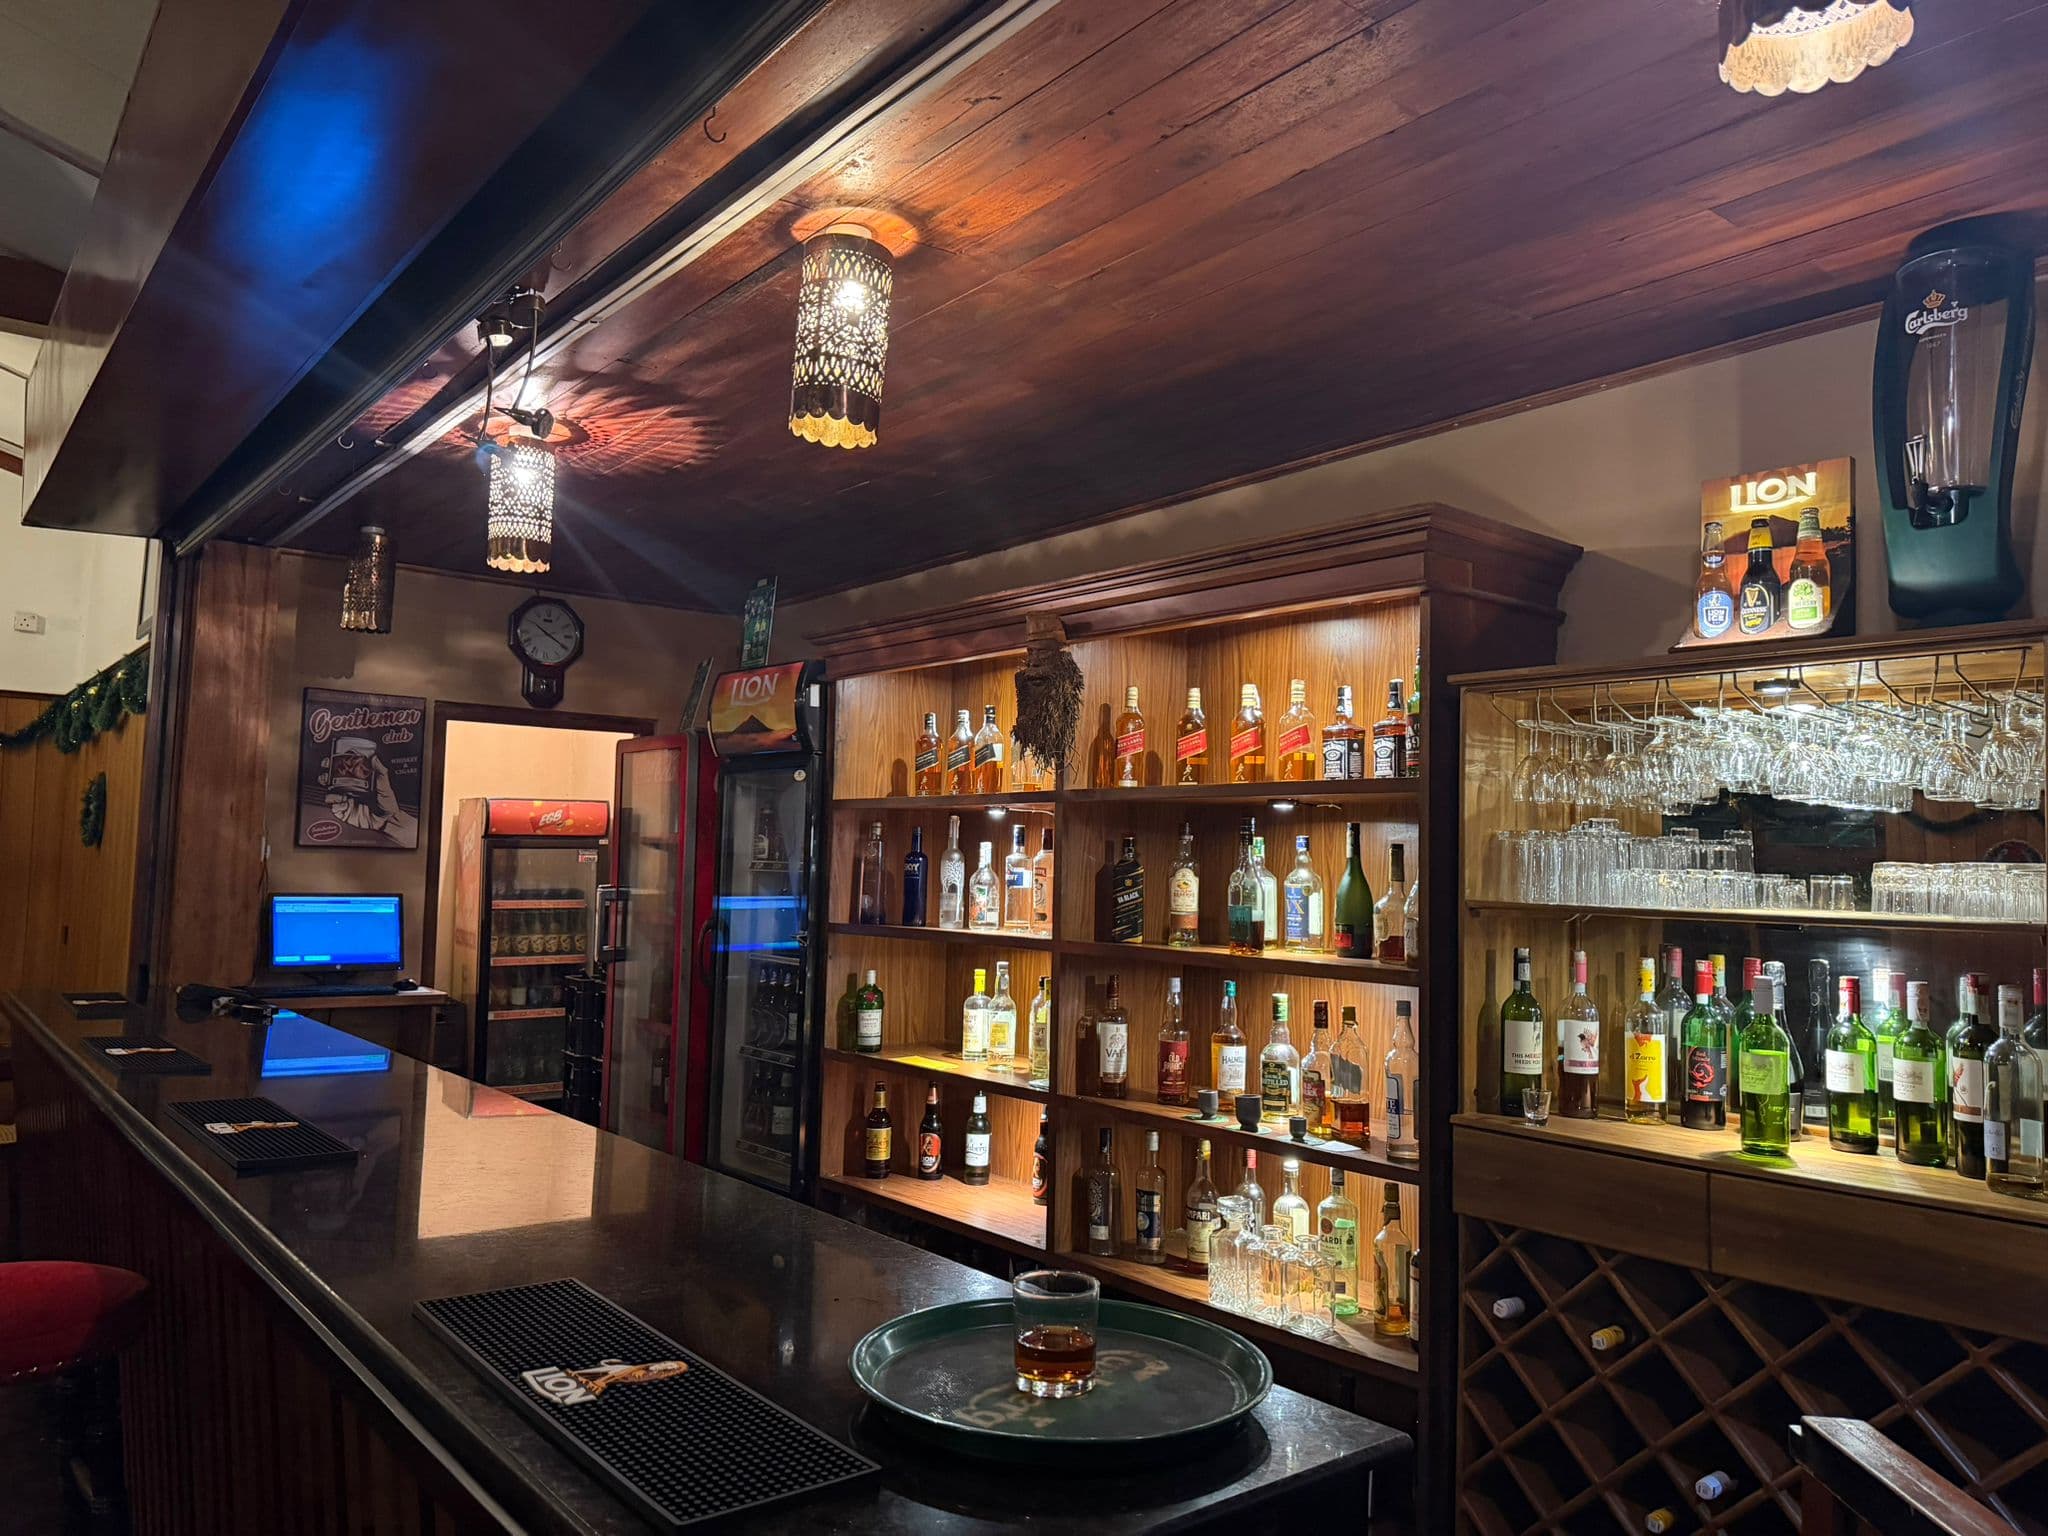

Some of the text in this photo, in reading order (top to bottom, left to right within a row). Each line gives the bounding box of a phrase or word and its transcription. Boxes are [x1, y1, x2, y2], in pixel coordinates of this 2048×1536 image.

[1905, 302, 1969, 334] Carlsberg
[1729, 471, 1817, 513] LION
[731, 673, 779, 706] LION
[309, 707, 421, 743] Gentlemen
[382, 728, 414, 744] club
[521, 1366, 599, 1406] LION
